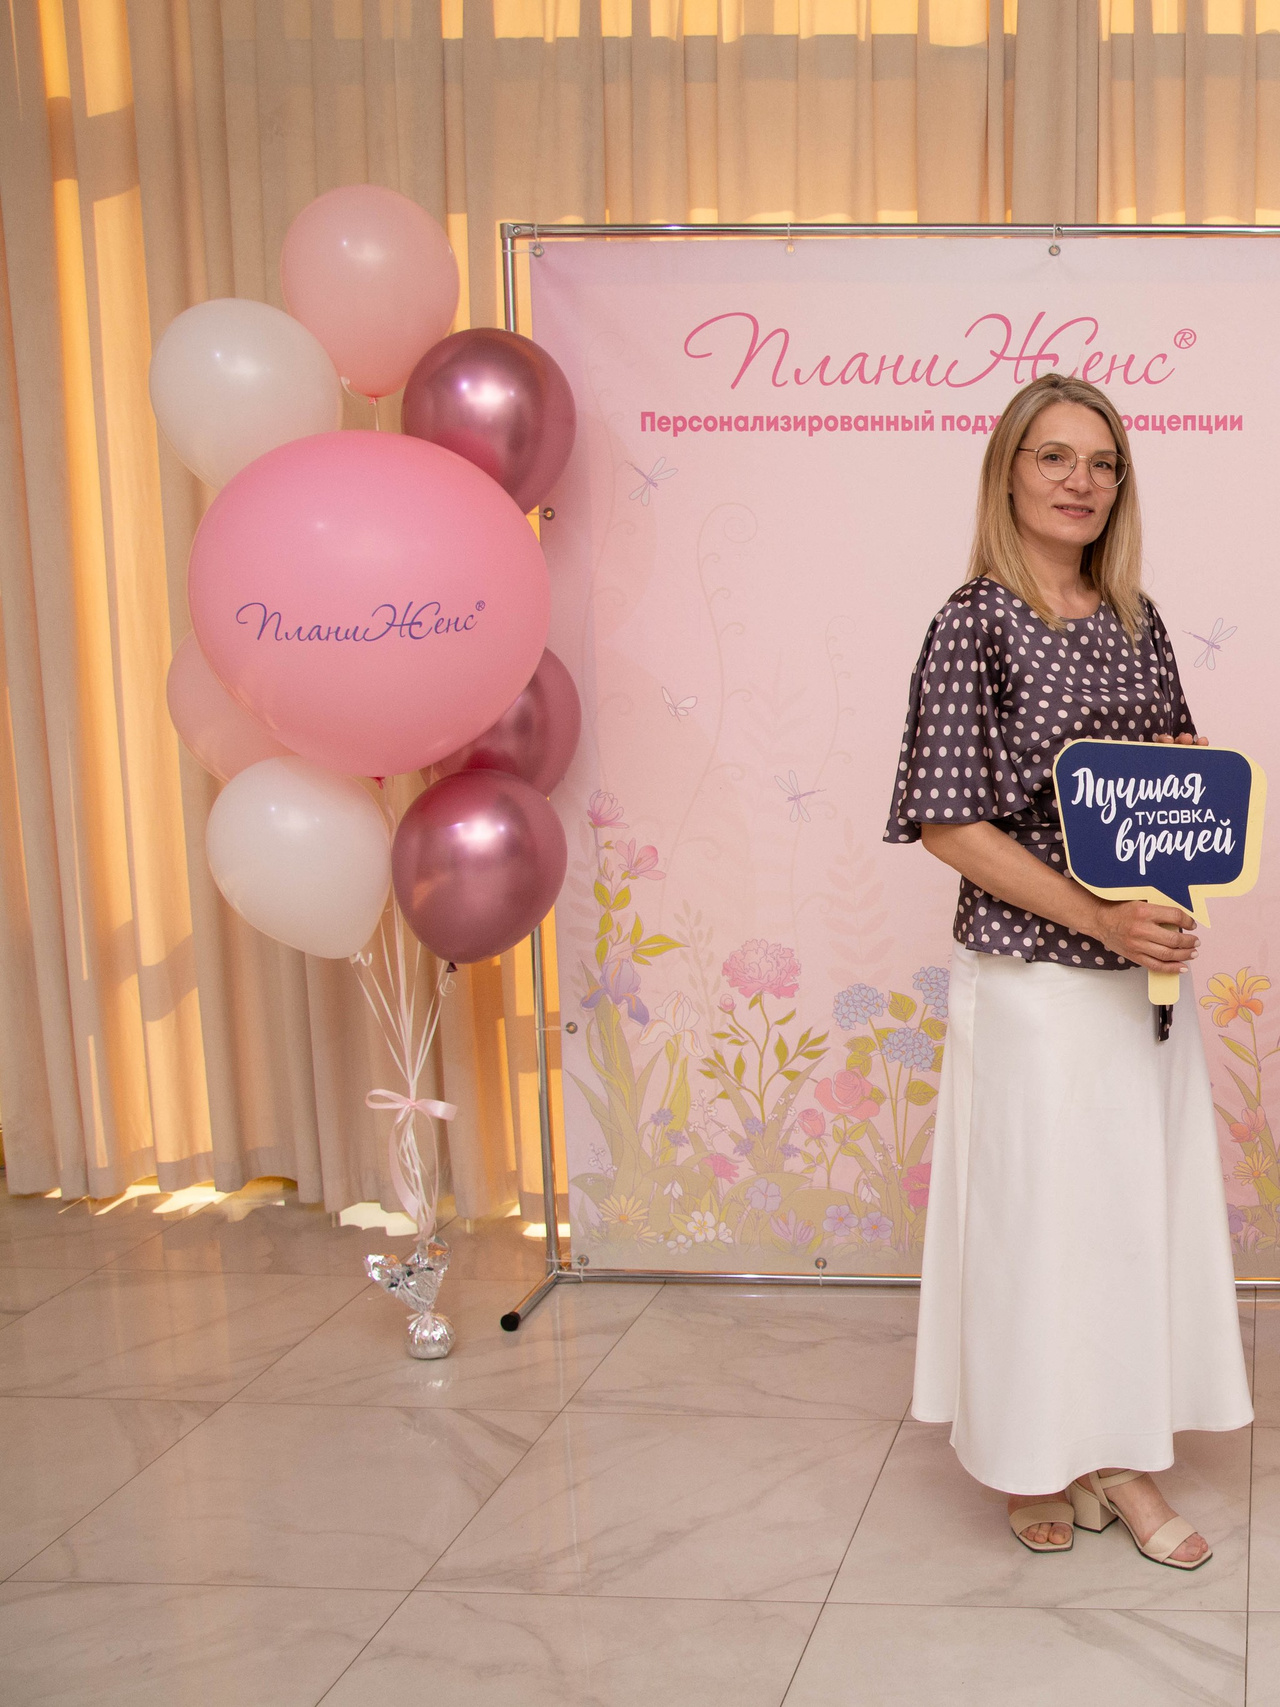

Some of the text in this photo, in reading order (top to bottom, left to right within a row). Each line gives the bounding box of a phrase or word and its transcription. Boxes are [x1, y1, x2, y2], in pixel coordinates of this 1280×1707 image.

[640, 410, 1243, 437] Персонализированный подх рацепции
[1071, 767, 1206, 824] Лучшая
[1135, 808, 1216, 825] ТУСОВКА
[1115, 817, 1236, 876] врачей
